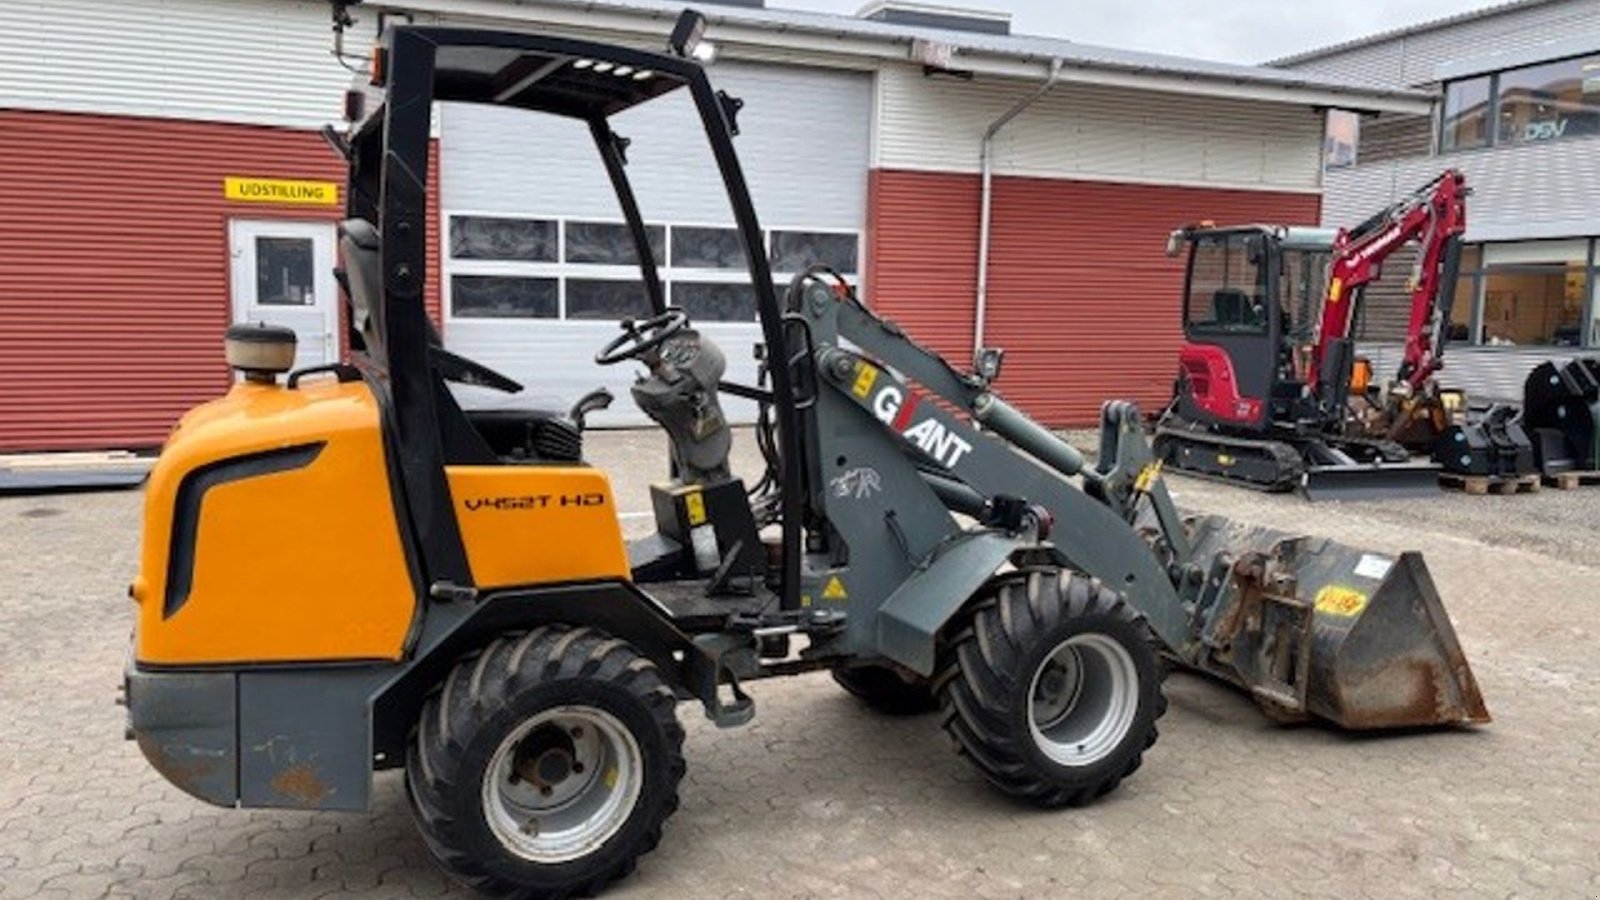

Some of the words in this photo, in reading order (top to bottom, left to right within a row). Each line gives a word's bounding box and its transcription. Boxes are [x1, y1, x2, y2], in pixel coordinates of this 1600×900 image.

[1525, 118, 1568, 139] DSV
[239, 182, 325, 199] UDSTILLING
[873, 386, 973, 469] GIANT
[464, 495, 552, 511] V452T
[560, 493, 604, 507] HD
